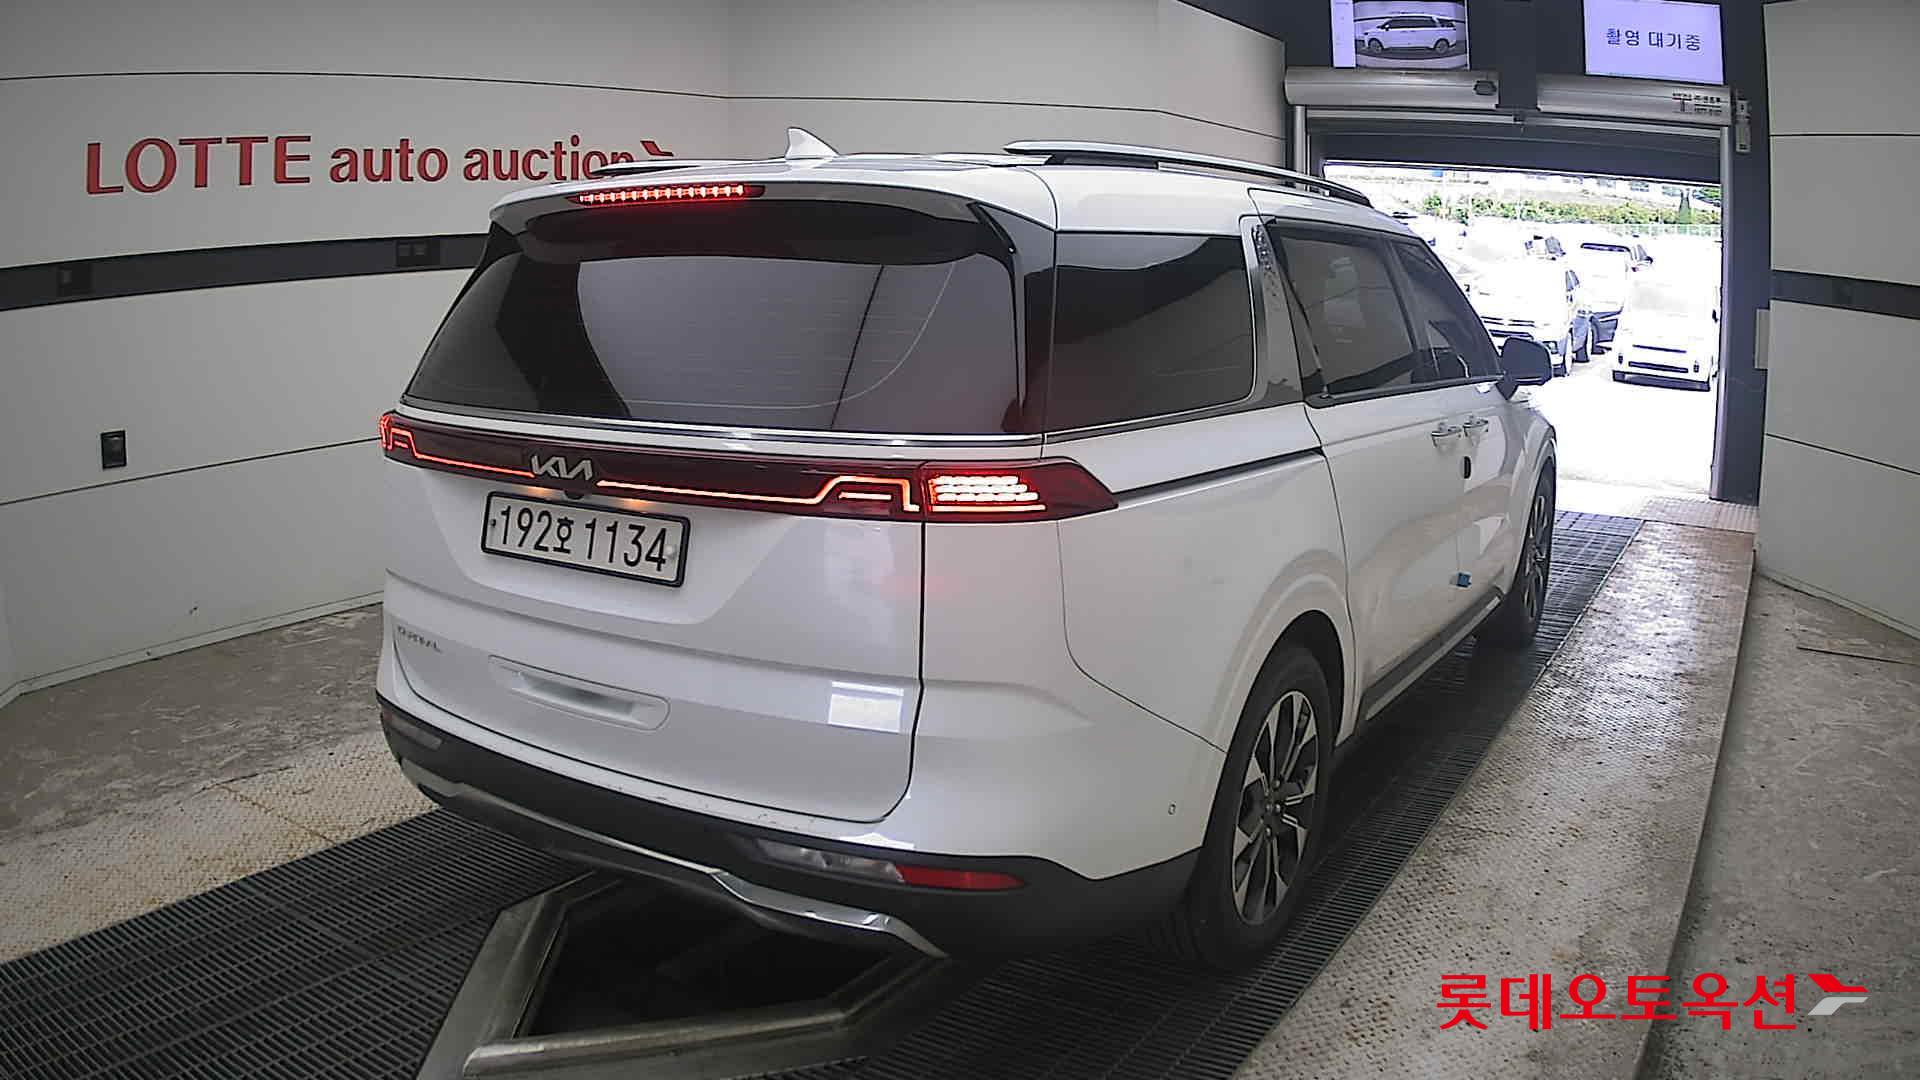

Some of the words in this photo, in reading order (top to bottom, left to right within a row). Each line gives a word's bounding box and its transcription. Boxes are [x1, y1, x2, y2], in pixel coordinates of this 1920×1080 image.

[1606, 28, 1640, 47] 촬영
[1648, 31, 1701, 51] 대기중
[86, 135, 312, 194] LOTTE
[329, 138, 449, 182] auto
[530, 455, 593, 481] KIA
